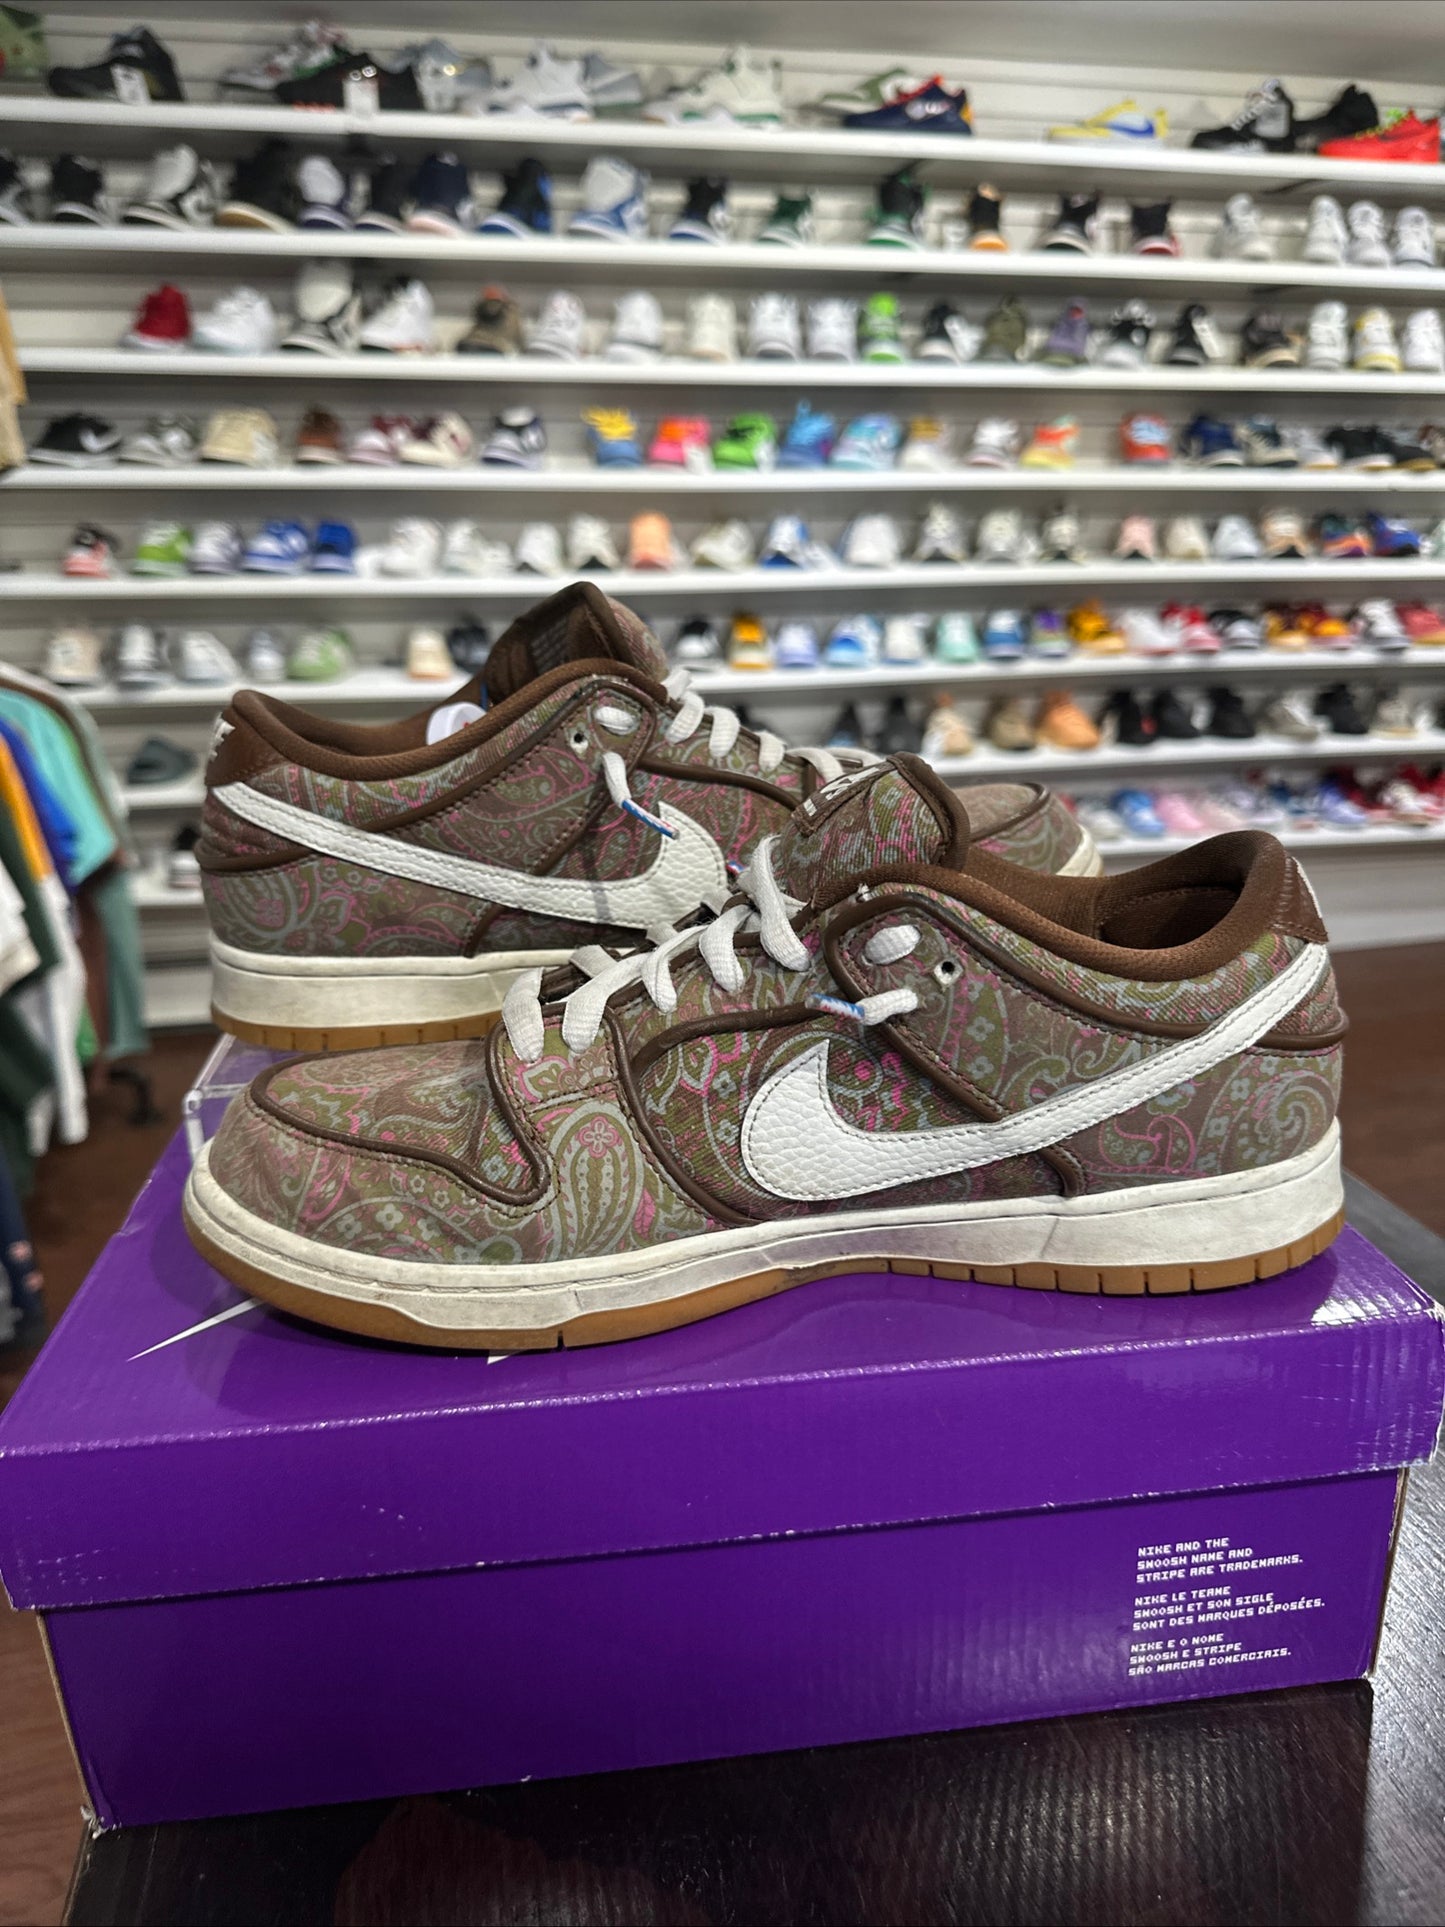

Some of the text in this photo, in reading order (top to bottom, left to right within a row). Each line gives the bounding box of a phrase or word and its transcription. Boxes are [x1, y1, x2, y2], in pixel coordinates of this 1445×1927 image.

[1137, 1547, 1253, 1570] SWOOSH NAME AND
[1138, 1537, 1229, 1557] NIKE AND THE
[1136, 1554, 1304, 1583] STRIPE ARE TRADEMARKS.
[1133, 1593, 1274, 1619] SWOOSH ET SON SIGLE
[1134, 1594, 1168, 1606] NIKE
[1172, 1592, 1186, 1602] LE
[1132, 1596, 1326, 1631] SONT DES MARQUES DÉPOSÉES.
[1129, 1642, 1242, 1665] SWOOSH E STRIPE
[1131, 1633, 1225, 1653] NIKE E O NOME
[1157, 1658, 1205, 1673] MARCAS
[1208, 1647, 1292, 1666] COMERCIAIS.
